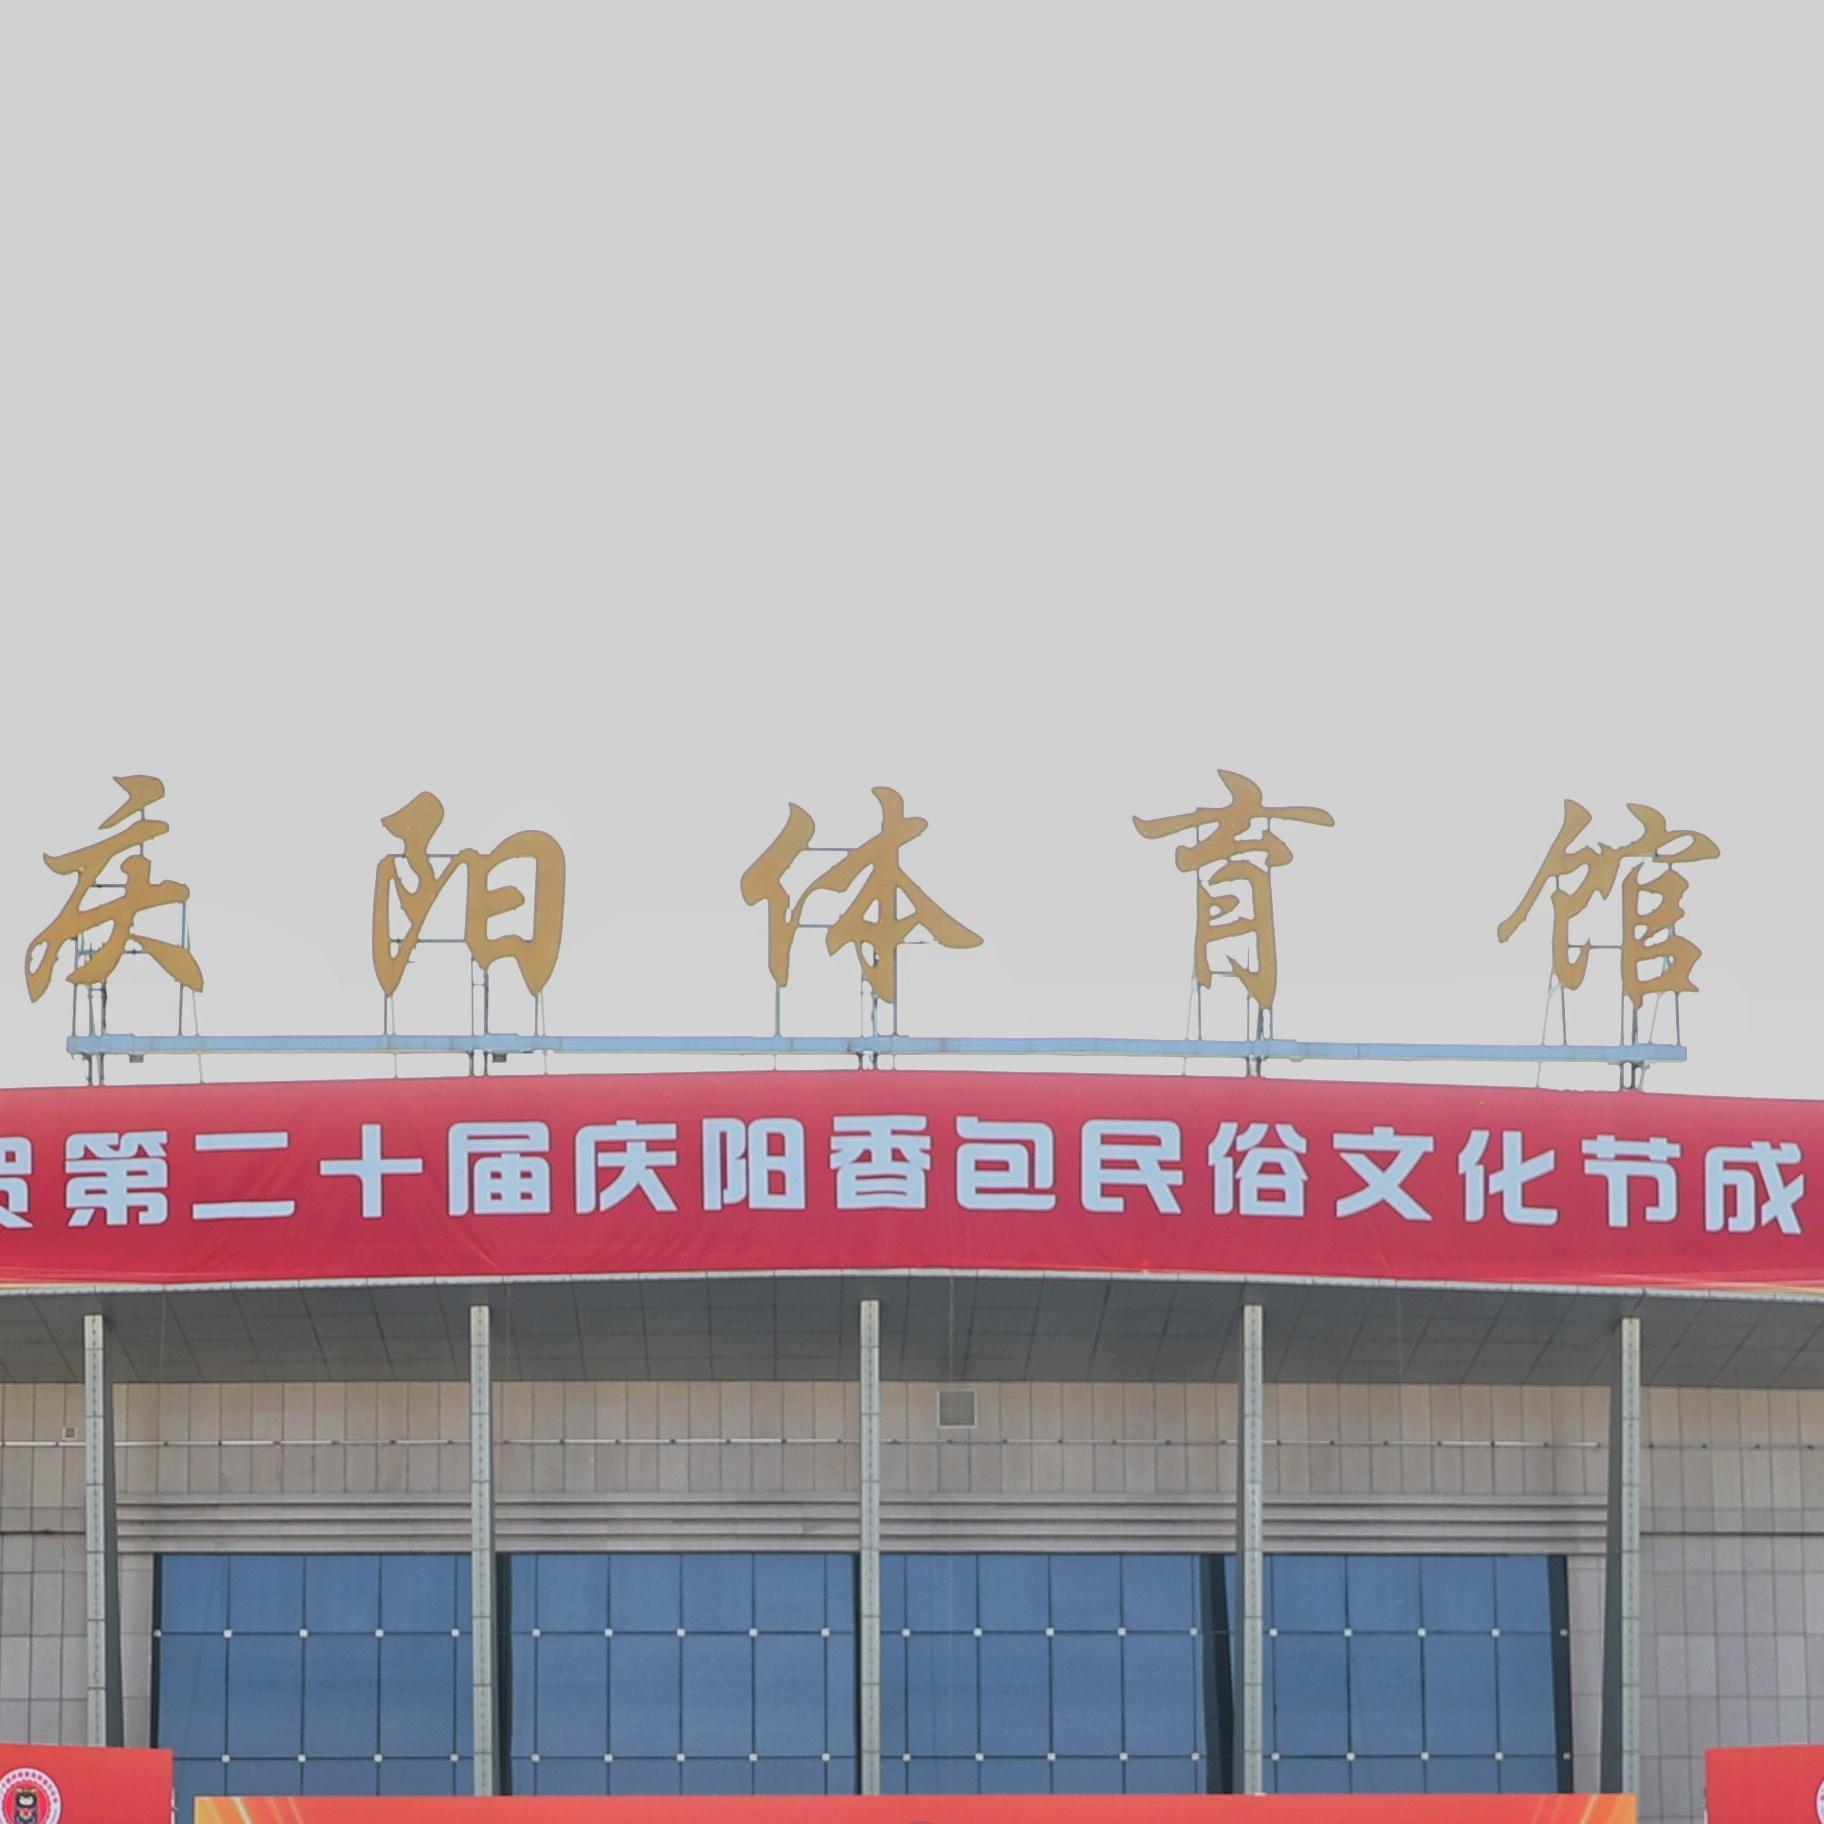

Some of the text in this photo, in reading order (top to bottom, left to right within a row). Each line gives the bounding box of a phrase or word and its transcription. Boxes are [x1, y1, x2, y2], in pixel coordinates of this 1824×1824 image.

[24, 767, 1722, 1005] 庆阳体育馆
